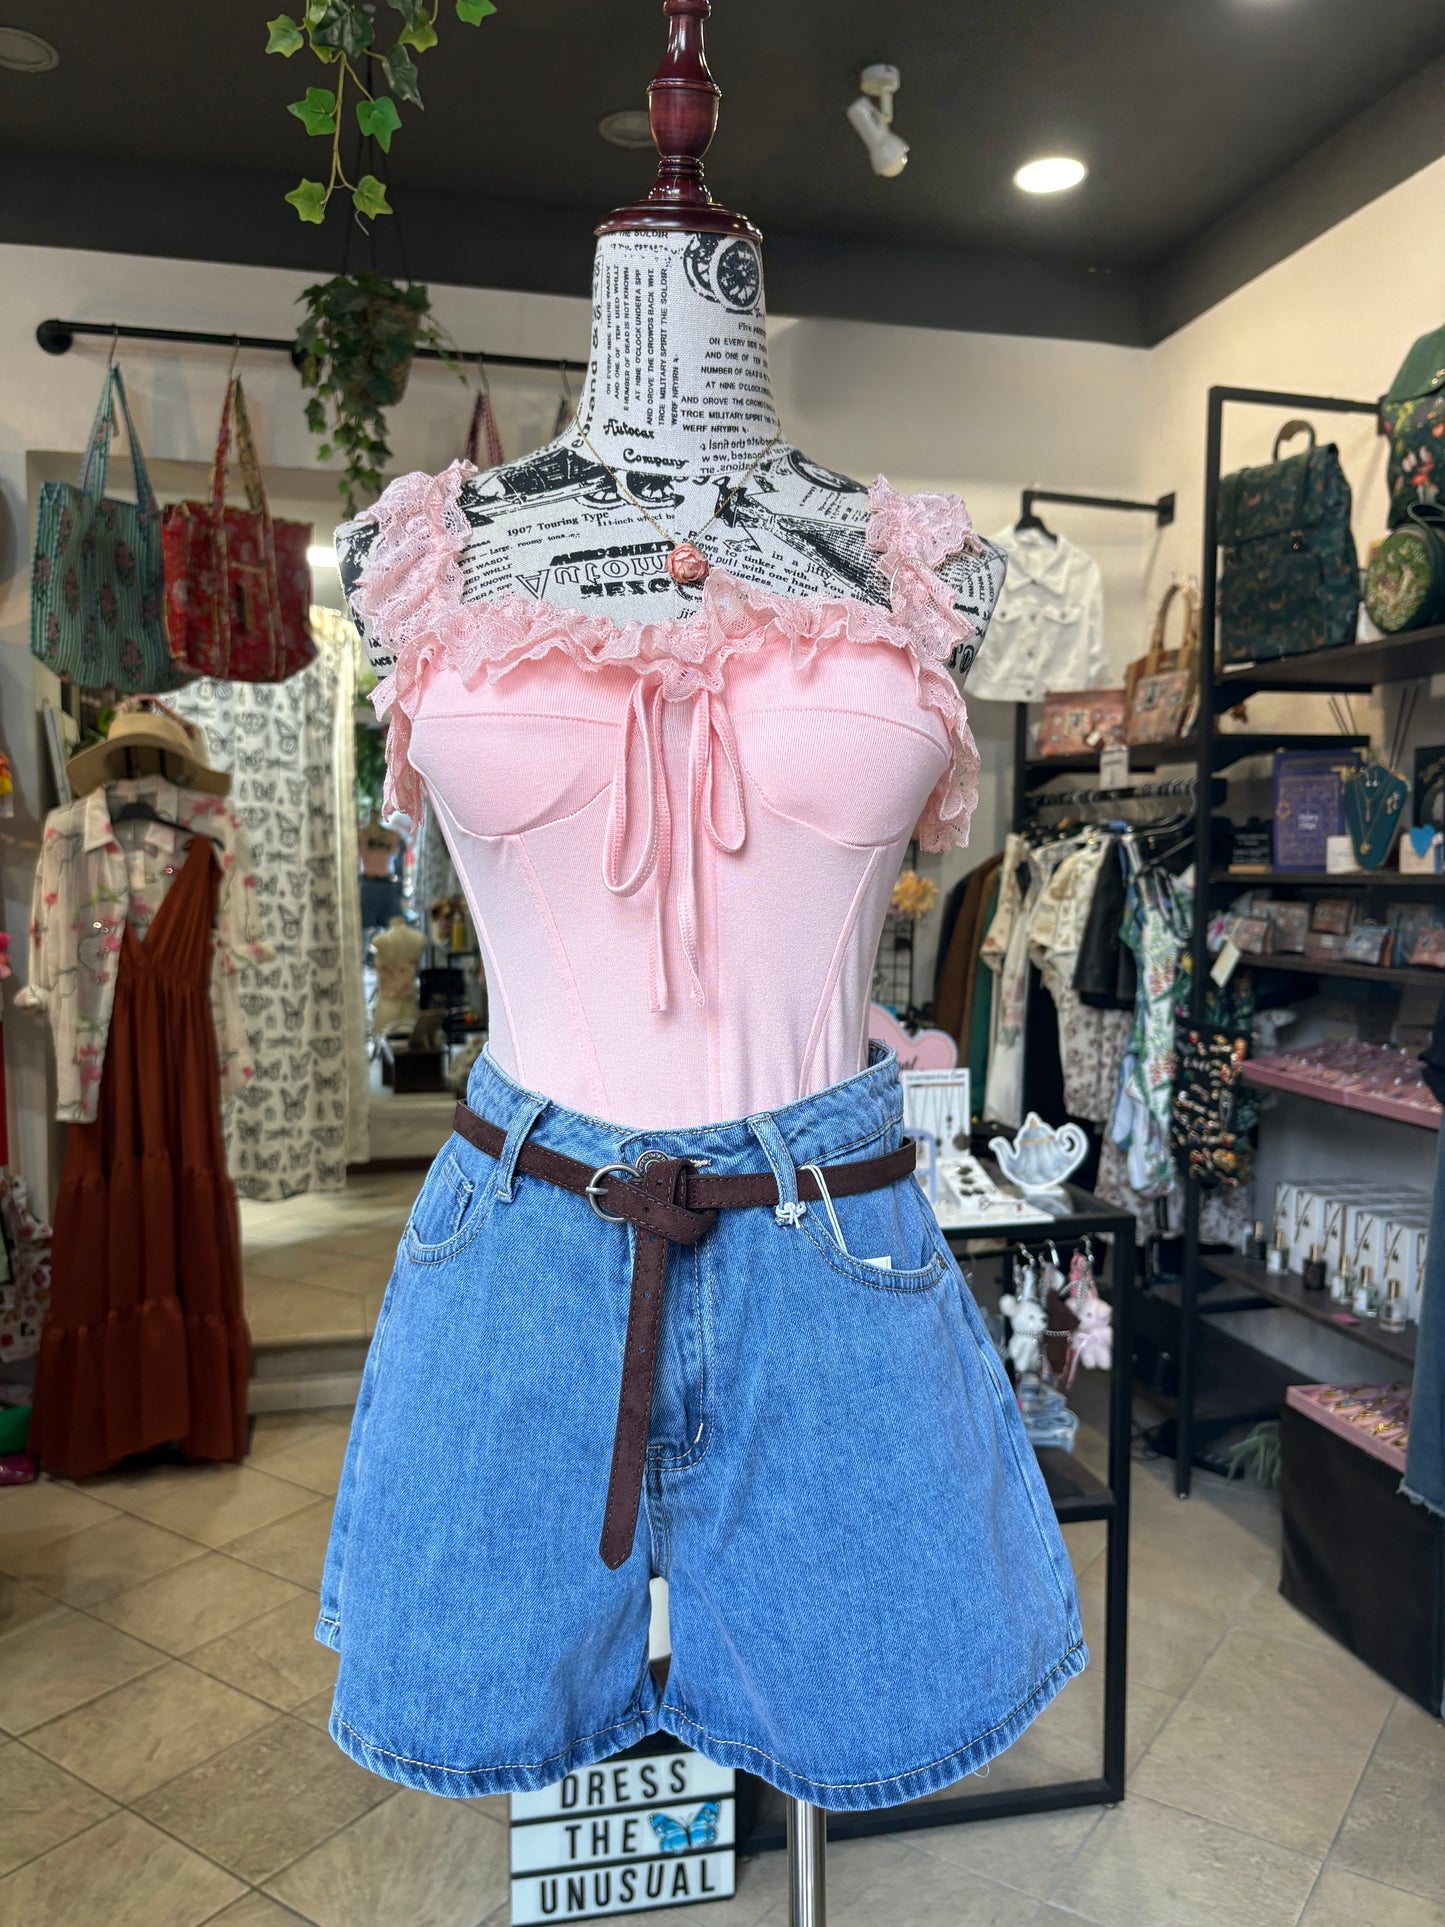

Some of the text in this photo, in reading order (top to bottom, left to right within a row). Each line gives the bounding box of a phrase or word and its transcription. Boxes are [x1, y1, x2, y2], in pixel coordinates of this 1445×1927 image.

[709, 337, 721, 346] ON
[724, 337, 746, 347] EVERY
[704, 351, 722, 360] AND
[725, 351, 739, 360] ONE
[741, 353, 750, 361] OF
[624, 357, 630, 368] OF
[700, 366, 733, 376] NUMBER
[734, 367, 743, 376] OF
[659, 360, 667, 400] MILITARY
[705, 381, 717, 389] AT
[719, 382, 736, 390] NINE
[635, 389, 641, 401] AT
[681, 395, 699, 404] AND
[702, 397, 729, 406] OROVE
[732, 398, 744, 406] THE
[681, 410, 704, 419] TRCE
[708, 411, 743, 421] MILITARY
[622, 448, 690, 470] Company
[507, 511, 610, 537] 1907 Touring Type
[637, 513, 663, 523] whel
[517, 538, 543, 548] roomy
[704, 534, 719, 543] or
[771, 550, 784, 561] in
[791, 559, 799, 567] a
[725, 549, 738, 558] to
[744, 554, 776, 570] tinker
[783, 567, 810, 581] with.
[715, 556, 738, 567] pull
[741, 563, 765, 575] with
[768, 572, 789, 583] one
[791, 577, 819, 593] hand
[480, 573, 513, 589] KNOWN
[787, 585, 796, 594] It
[822, 580, 845, 595] You
[560, 1758, 687, 1809] DRESS
[565, 1818, 640, 1860] THE
[540, 1858, 716, 1914] UNUSUAL
